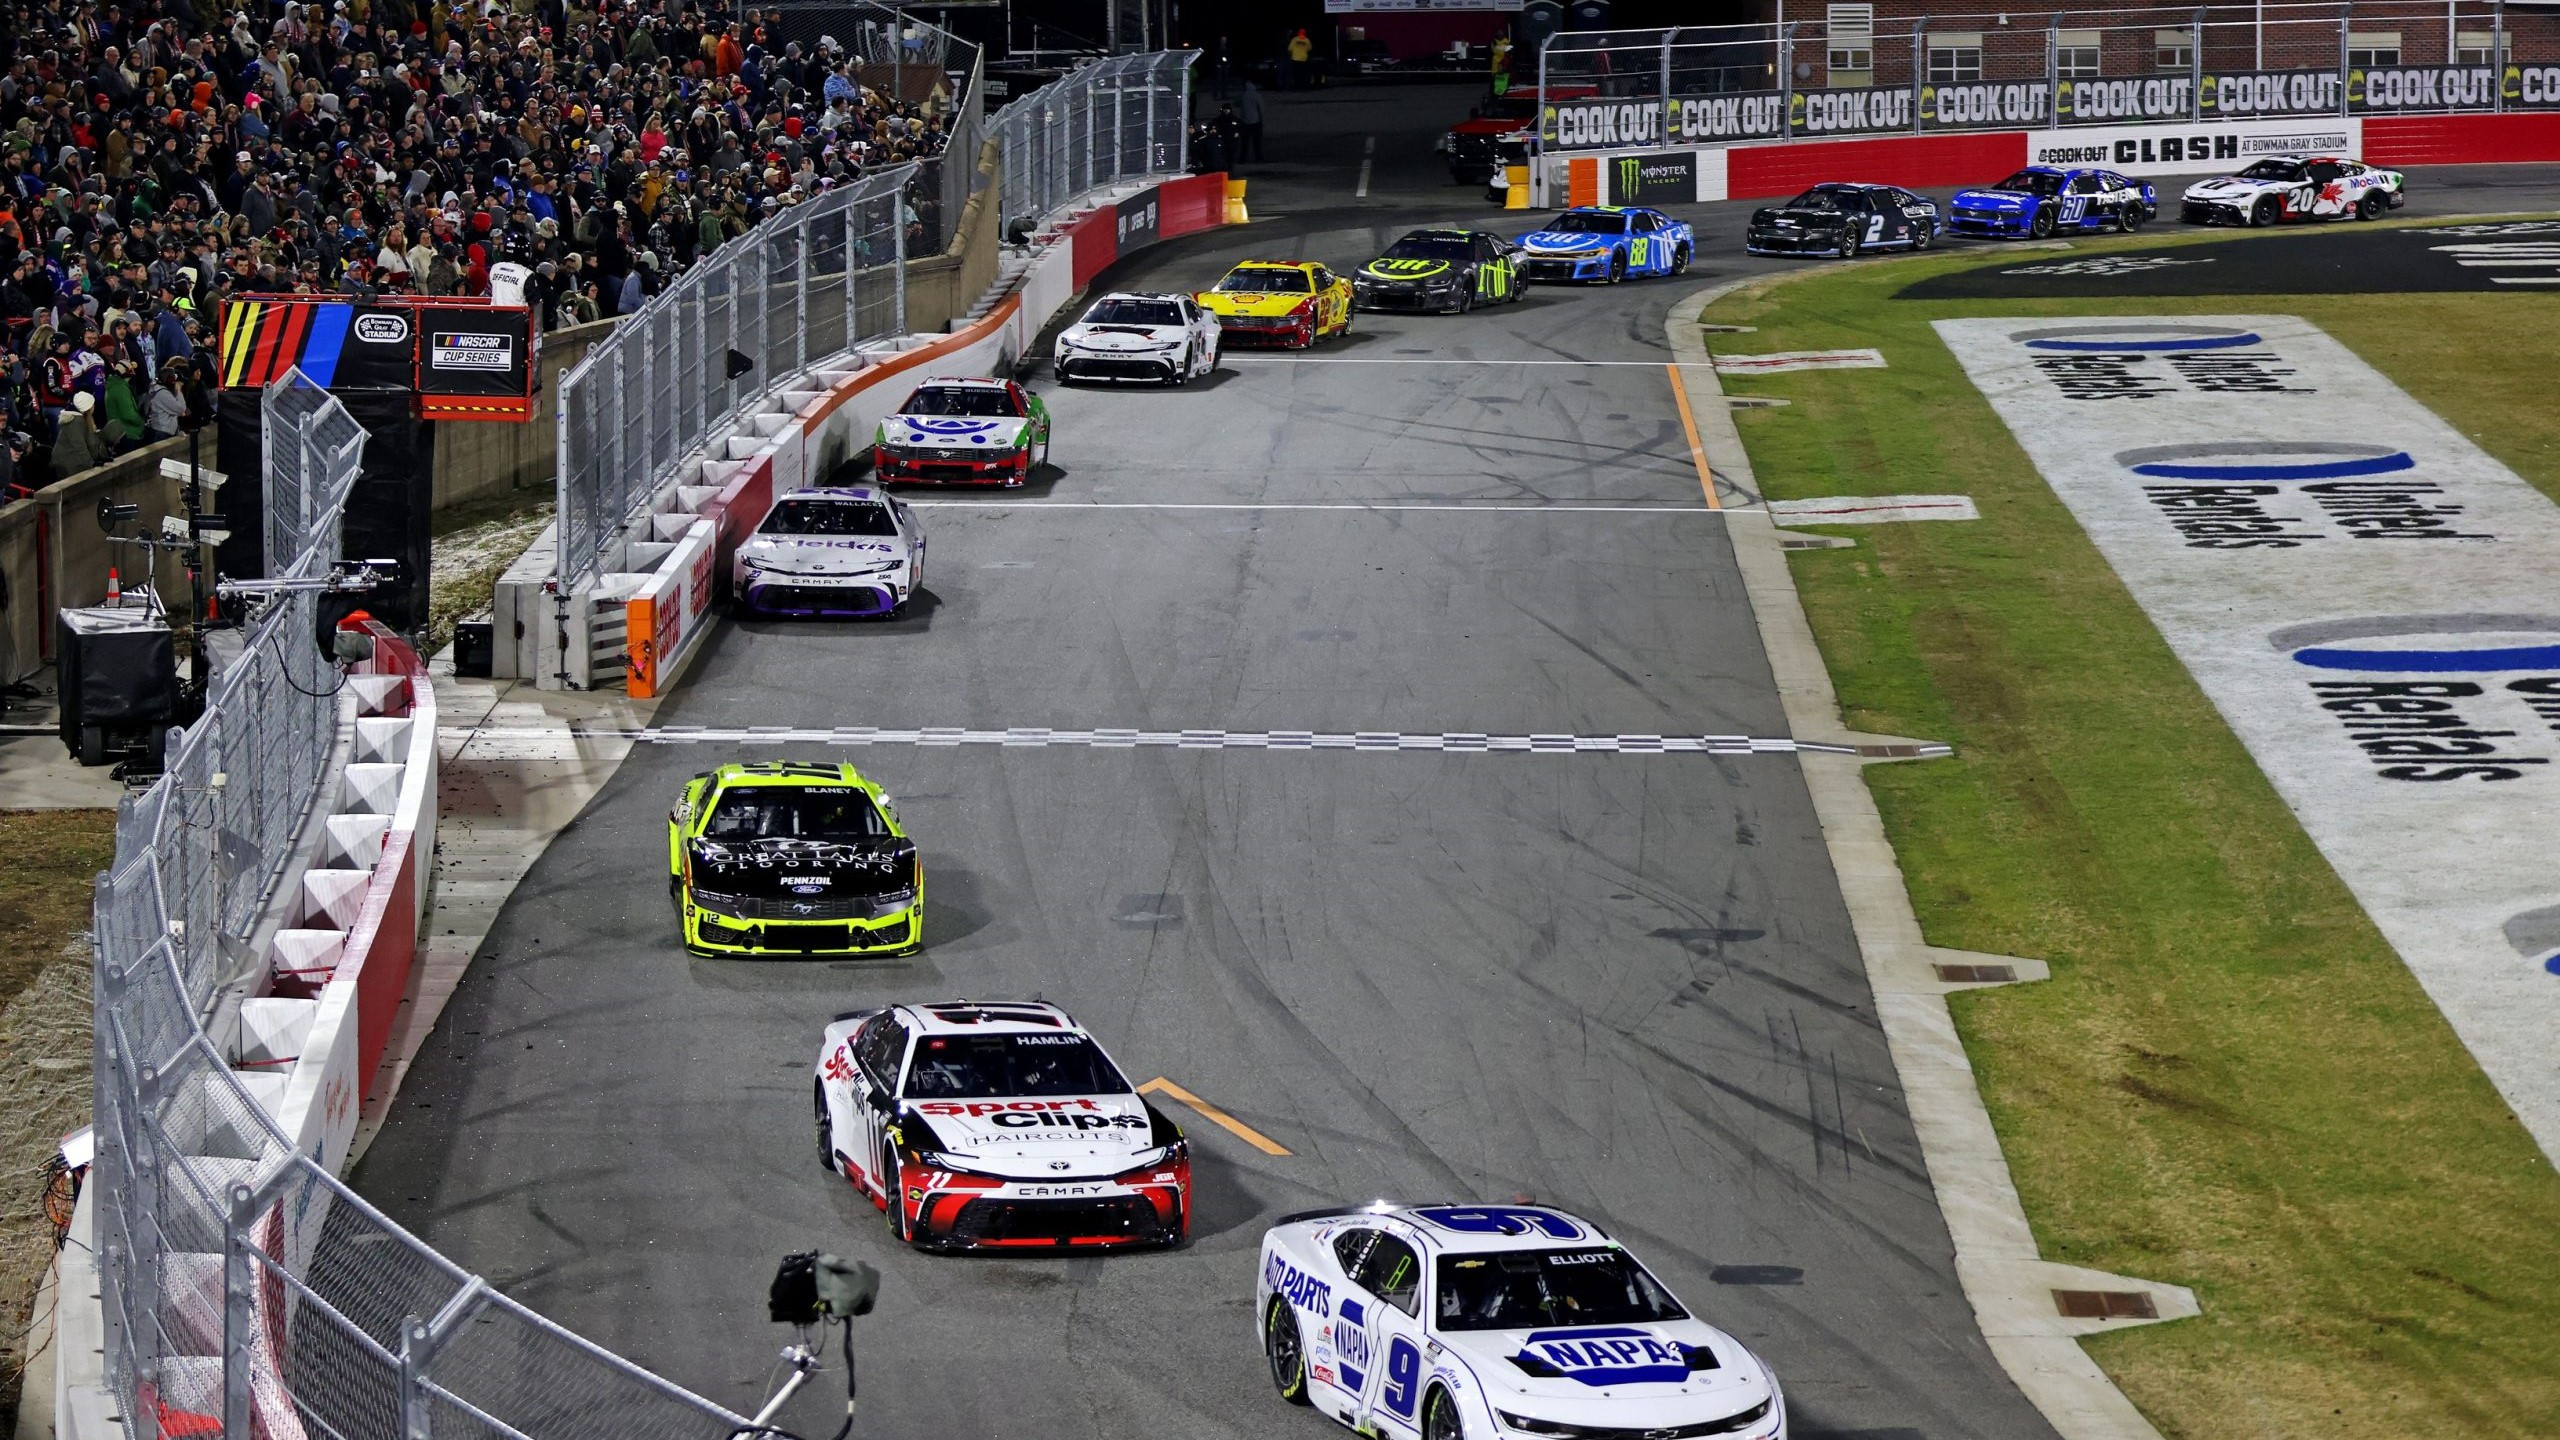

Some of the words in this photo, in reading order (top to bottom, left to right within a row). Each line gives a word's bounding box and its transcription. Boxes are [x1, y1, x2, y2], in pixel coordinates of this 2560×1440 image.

[2074, 80, 2142, 118] COOK
[2144, 78, 2193, 115] OUT
[2218, 74, 2288, 112] COOK
[2290, 73, 2338, 109] OUT
[2366, 69, 2440, 106] COOK
[2442, 68, 2491, 104] OUT
[1806, 92, 1869, 131] COOK
[1870, 89, 1912, 128] OUT
[1937, 85, 2003, 123] COOK
[2004, 83, 2049, 121] OUT
[1558, 105, 1618, 145] COOK
[1619, 103, 1660, 142] OUT
[1682, 97, 1741, 137] COOK
[1742, 95, 1782, 133] OUT
[2049, 148, 2083, 164] COOK
[2084, 146, 2108, 162] OUT
[2114, 135, 2238, 164] CLASH
[2242, 140, 2250, 152] AT
[2252, 138, 2289, 151] BOWMAN
[2290, 137, 2310, 149] GRAY
[2312, 136, 2347, 148] STADIUM
[1640, 165, 1687, 178] MONSTER
[2350, 175, 2379, 189] Mobil
[2058, 196, 2088, 224] 60
[2286, 187, 2315, 212] 20
[1864, 214, 1885, 242] 2
[1629, 237, 1648, 267] 88
[492, 273, 520, 286] OFFICIAL
[364, 330, 399, 339] STADIUM
[458, 336, 501, 349] NASCAR
[443, 351, 464, 362] CUP
[465, 352, 501, 363] SERIES
[2031, 353, 2178, 400] Rentals
[2163, 352, 2317, 393] United
[2141, 485, 2326, 549] Rentals
[2299, 481, 2494, 539] United
[2308, 680, 2551, 782] Rentals
[713, 851, 803, 863] GREAT
[816, 851, 895, 863] LAKES
[717, 860, 894, 874] FLOORING
[780, 876, 833, 886] PENNZOIL
[706, 912, 720, 924] 12
[1016, 1036, 1082, 1046] HAMLIN
[919, 1098, 1103, 1118] Sport
[991, 1111, 1149, 1131] Clips
[973, 1131, 1125, 1146] HAIRCUTS
[926, 1171, 953, 1188] 11
[1152, 1172, 1176, 1183] JGR
[1018, 1185, 1104, 1197] CAMRY
[1549, 1252, 1615, 1266] ELLIOTT
[1265, 1248, 1286, 1293] AUTO
[1281, 1265, 1331, 1319] PARTS
[1340, 1320, 1364, 1370] NAPA
[1540, 1339, 1682, 1368] NAPA
[1383, 1332, 1420, 1422] 9
